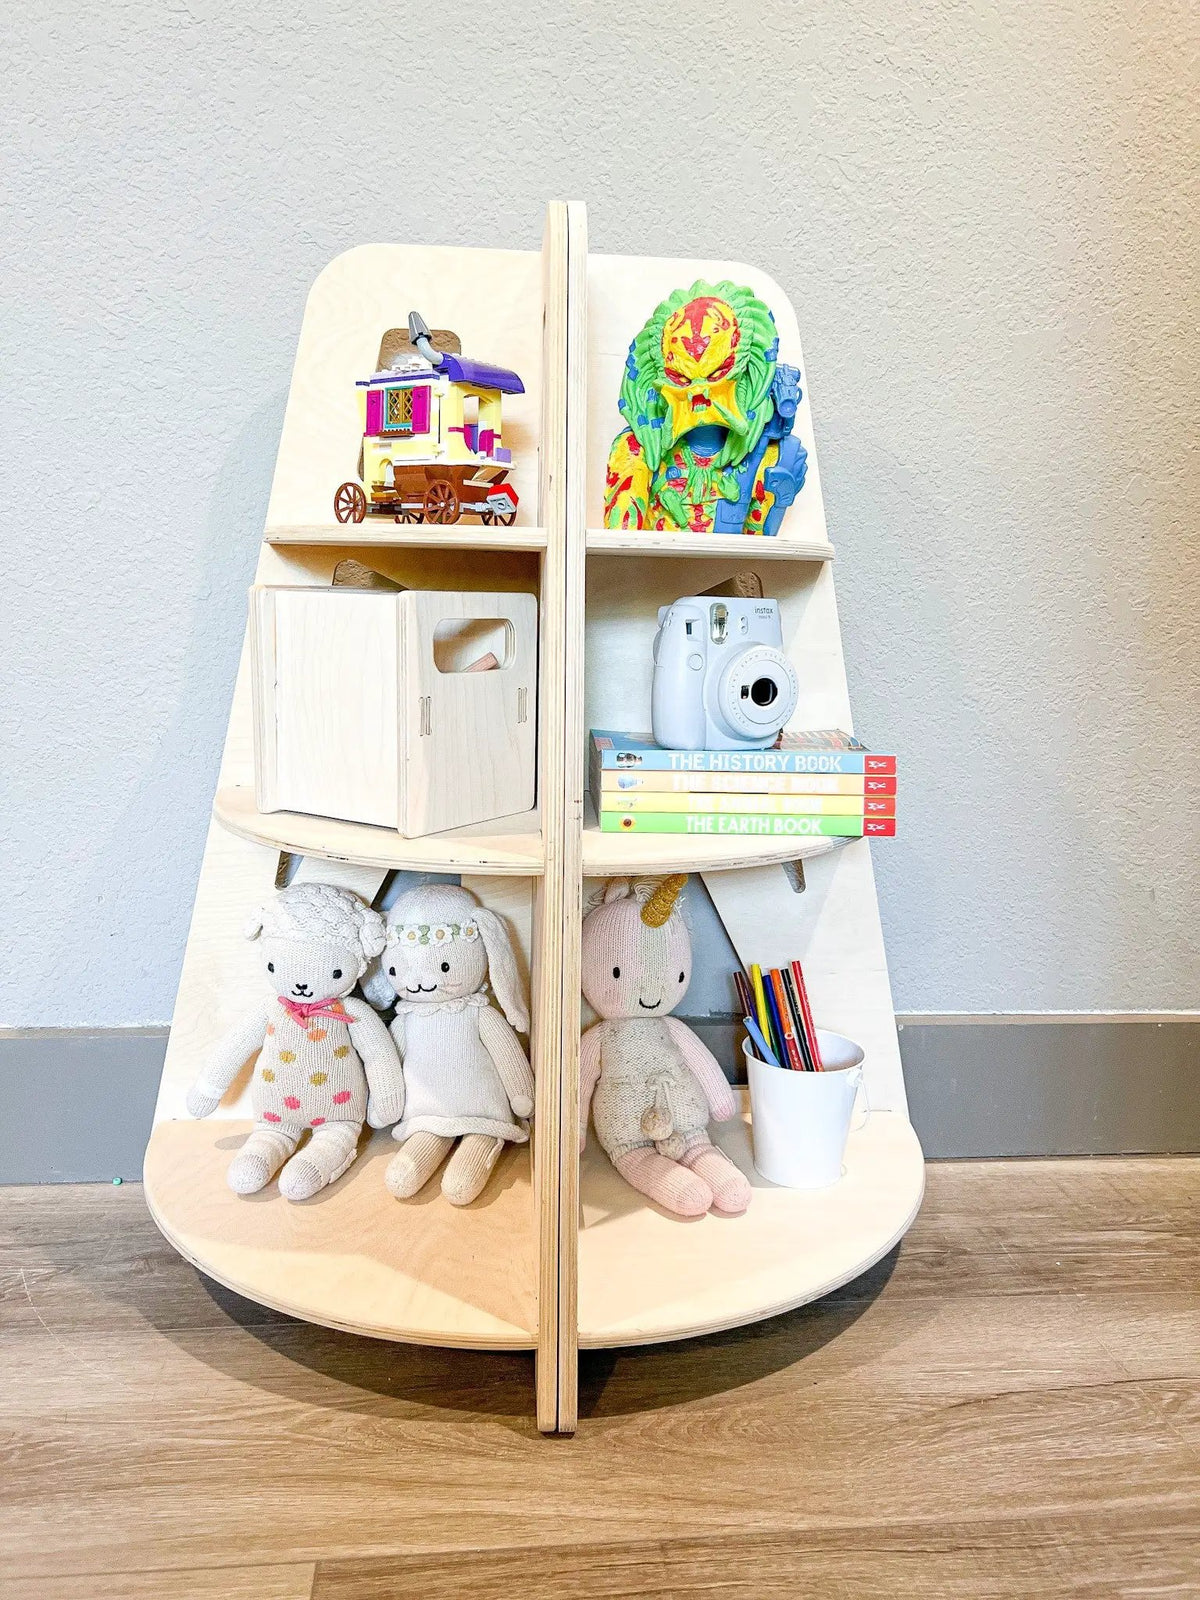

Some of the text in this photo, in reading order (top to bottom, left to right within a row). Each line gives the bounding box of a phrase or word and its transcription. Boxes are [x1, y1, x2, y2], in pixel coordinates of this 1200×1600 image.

[754, 606, 774, 614] instax
[667, 753, 842, 772] THE HISTORY BOOK
[672, 774, 705, 790] THE
[685, 816, 823, 834] THE EARTH BOOK
